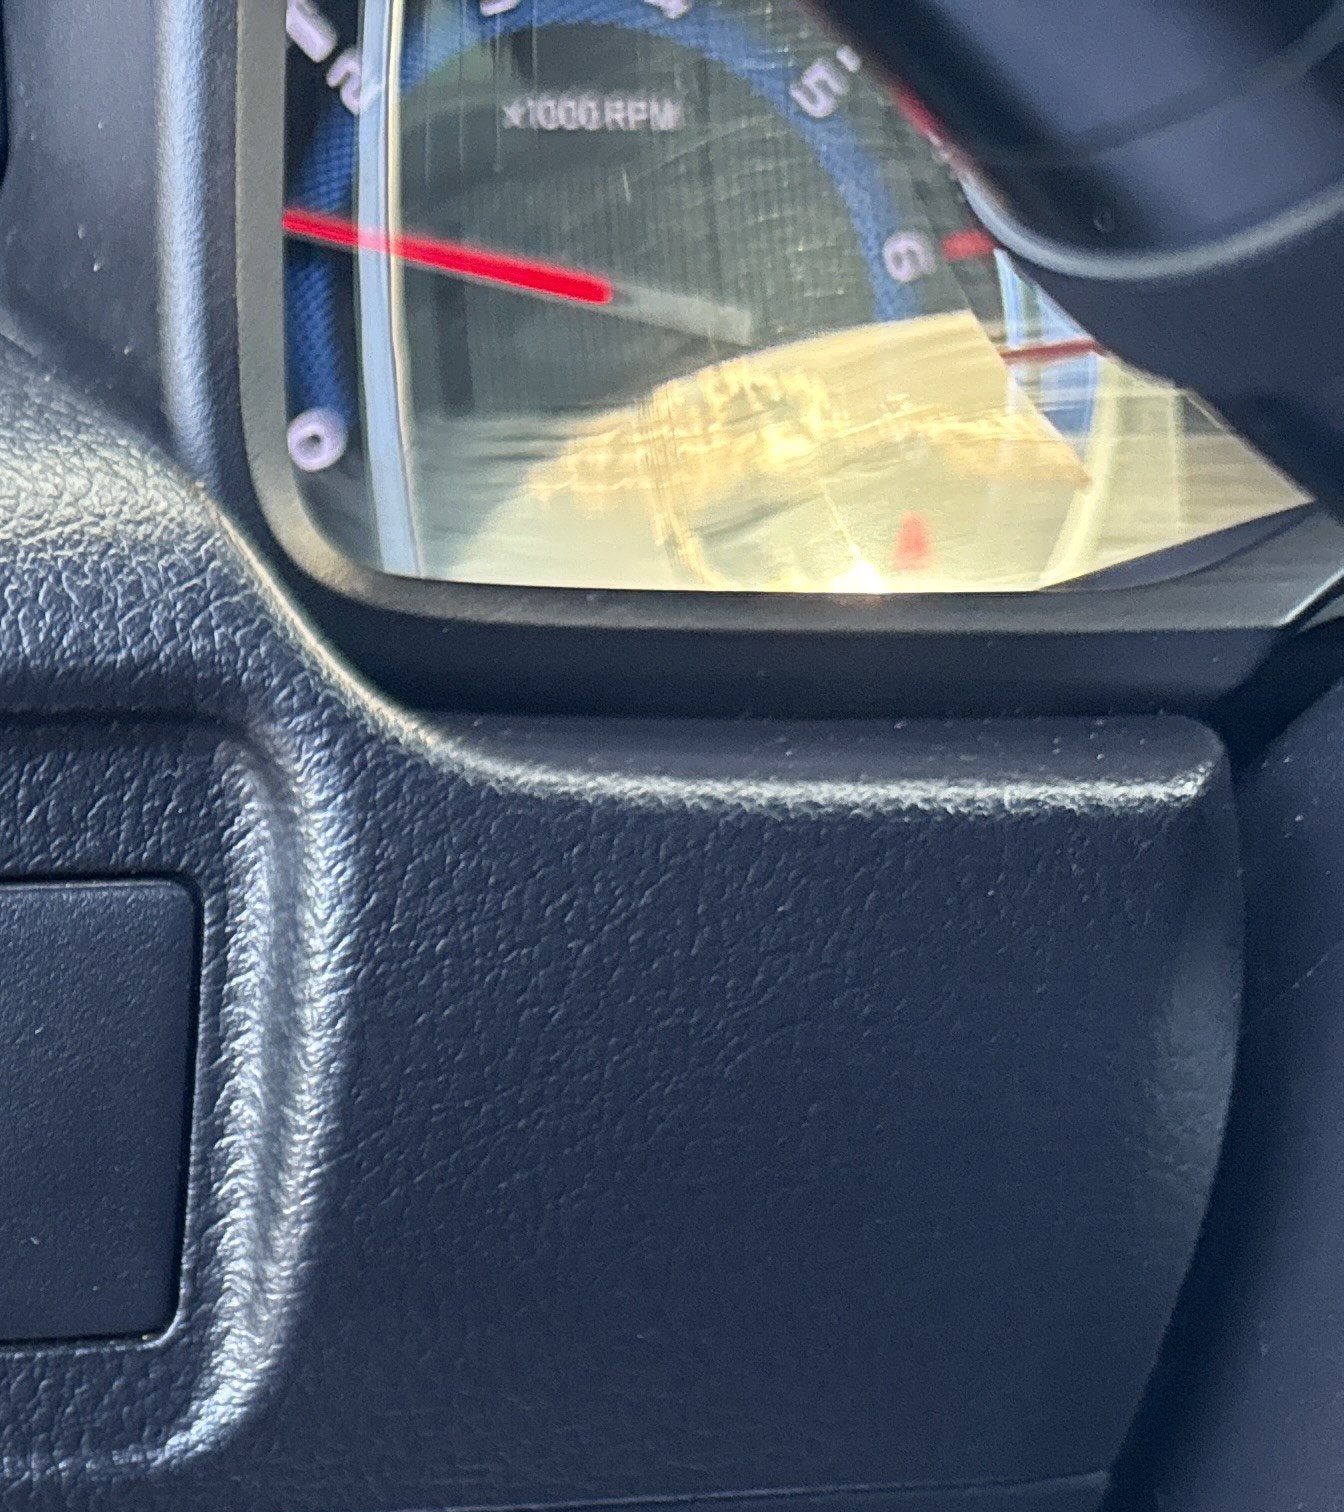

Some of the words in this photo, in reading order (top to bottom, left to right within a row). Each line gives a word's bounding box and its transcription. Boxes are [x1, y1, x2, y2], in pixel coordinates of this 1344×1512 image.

[604, 96, 685, 131] RPM
[789, 58, 850, 118] 5
[882, 230, 937, 283] 6
[287, 408, 348, 472] 0
